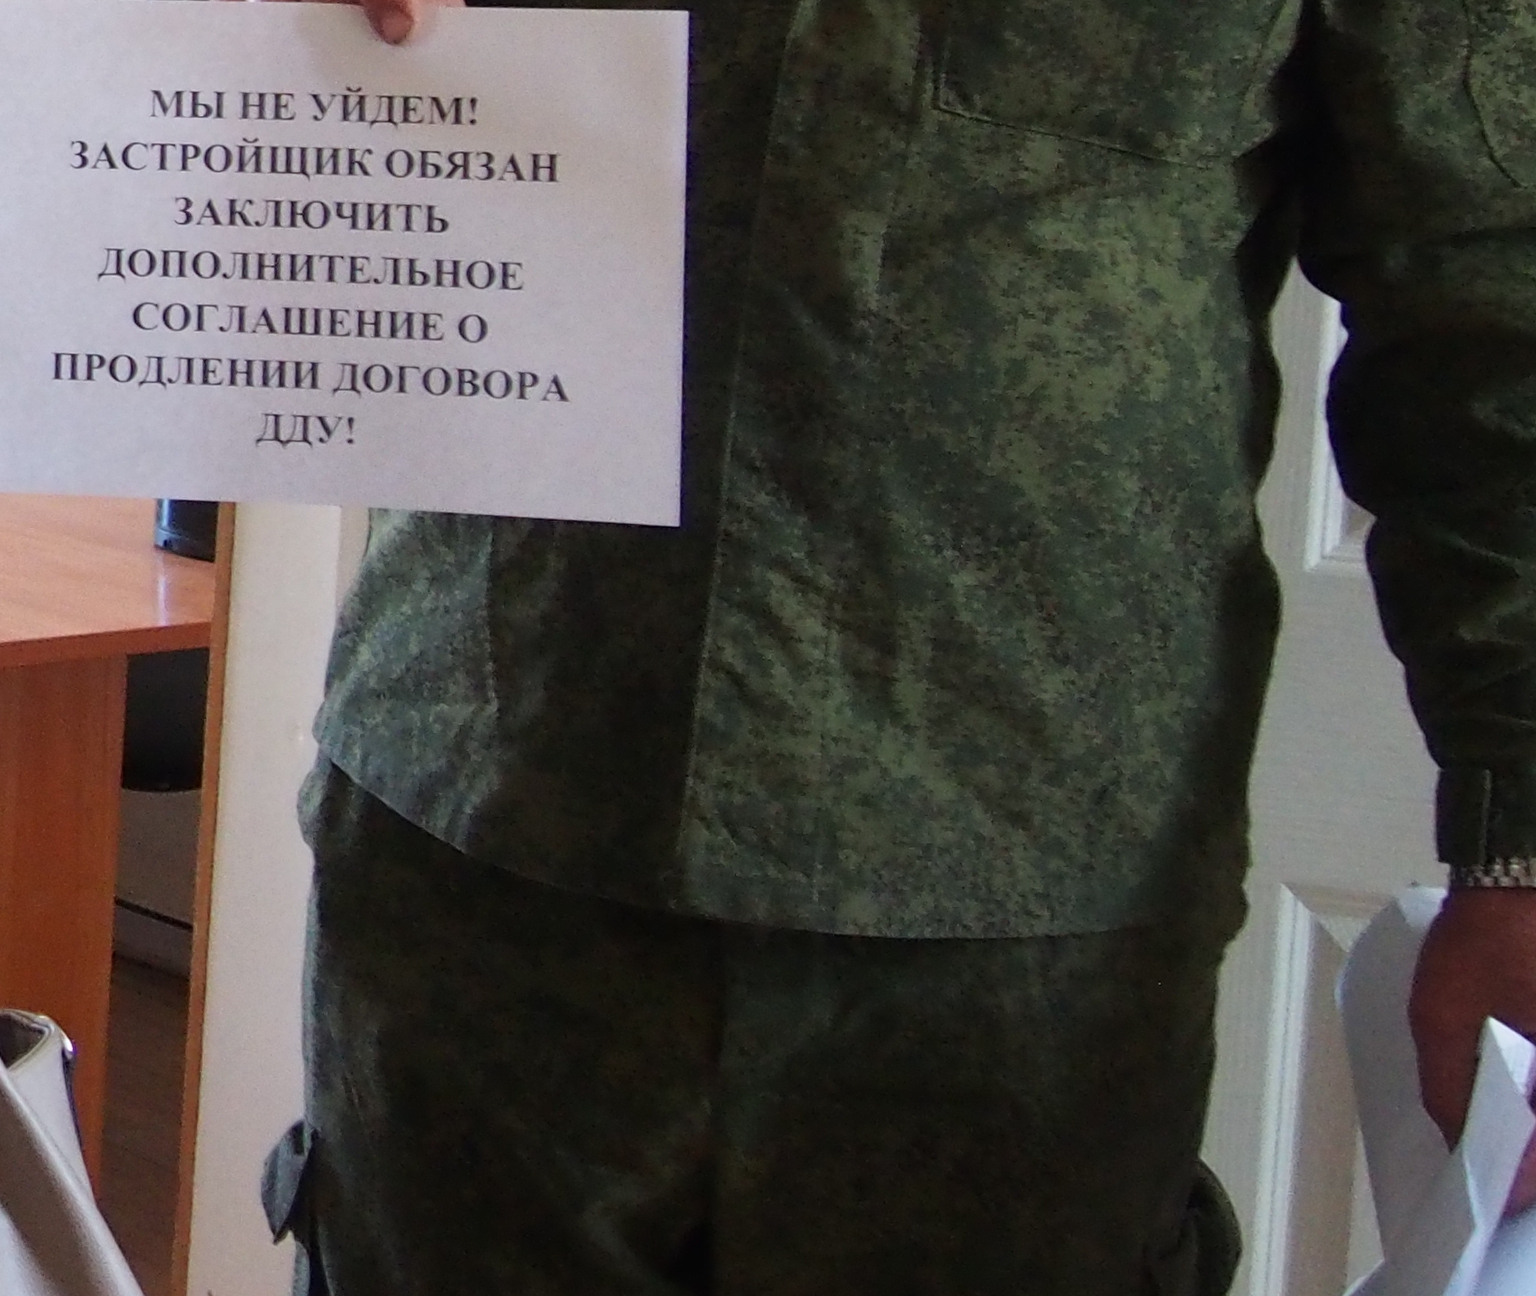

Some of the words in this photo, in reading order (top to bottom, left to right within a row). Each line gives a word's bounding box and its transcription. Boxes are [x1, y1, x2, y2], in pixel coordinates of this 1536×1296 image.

[151, 89, 225, 119] МЫ
[240, 91, 295, 121] НЕ
[309, 86, 478, 127] УЙДЕМ!
[69, 137, 374, 180] ЗАСТРОЙЩИК
[384, 149, 558, 183] ОБЯЗАН
[174, 196, 450, 234] ЗАКЛЮЧИТЬ
[97, 248, 523, 291] ДОПОЛНИТЕЛЬНОЕ
[132, 302, 444, 341] СОГЛАШЕНИЕ
[457, 314, 488, 344] О
[53, 352, 320, 390] ПРОДЛЕНИИ
[332, 362, 569, 402] ДОГОВОРА
[255, 413, 355, 447] ДДУ!
